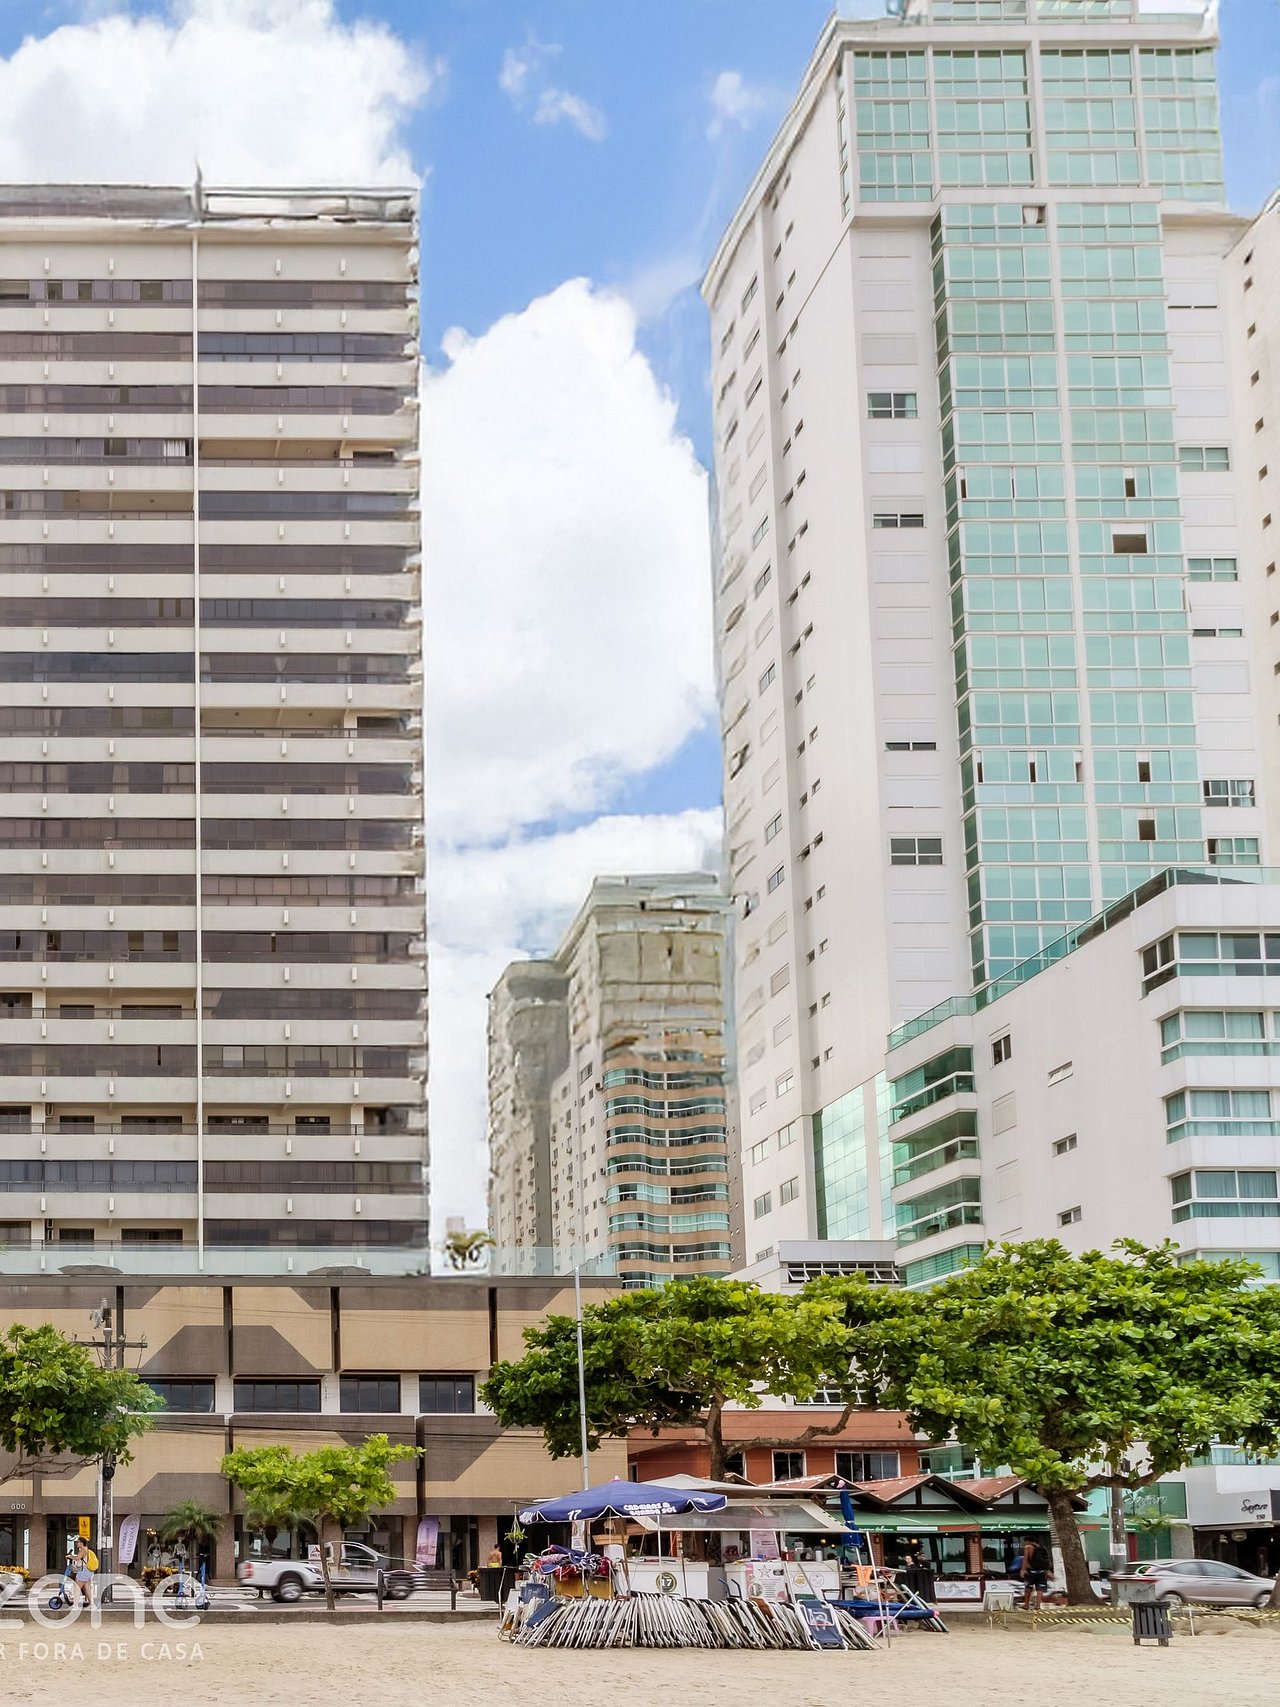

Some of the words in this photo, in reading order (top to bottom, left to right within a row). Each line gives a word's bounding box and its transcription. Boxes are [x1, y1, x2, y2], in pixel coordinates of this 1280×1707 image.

[10, 1503, 27, 1511] 600
[567, 1509, 582, 1521] 17
[661, 1578, 673, 1587] 17
